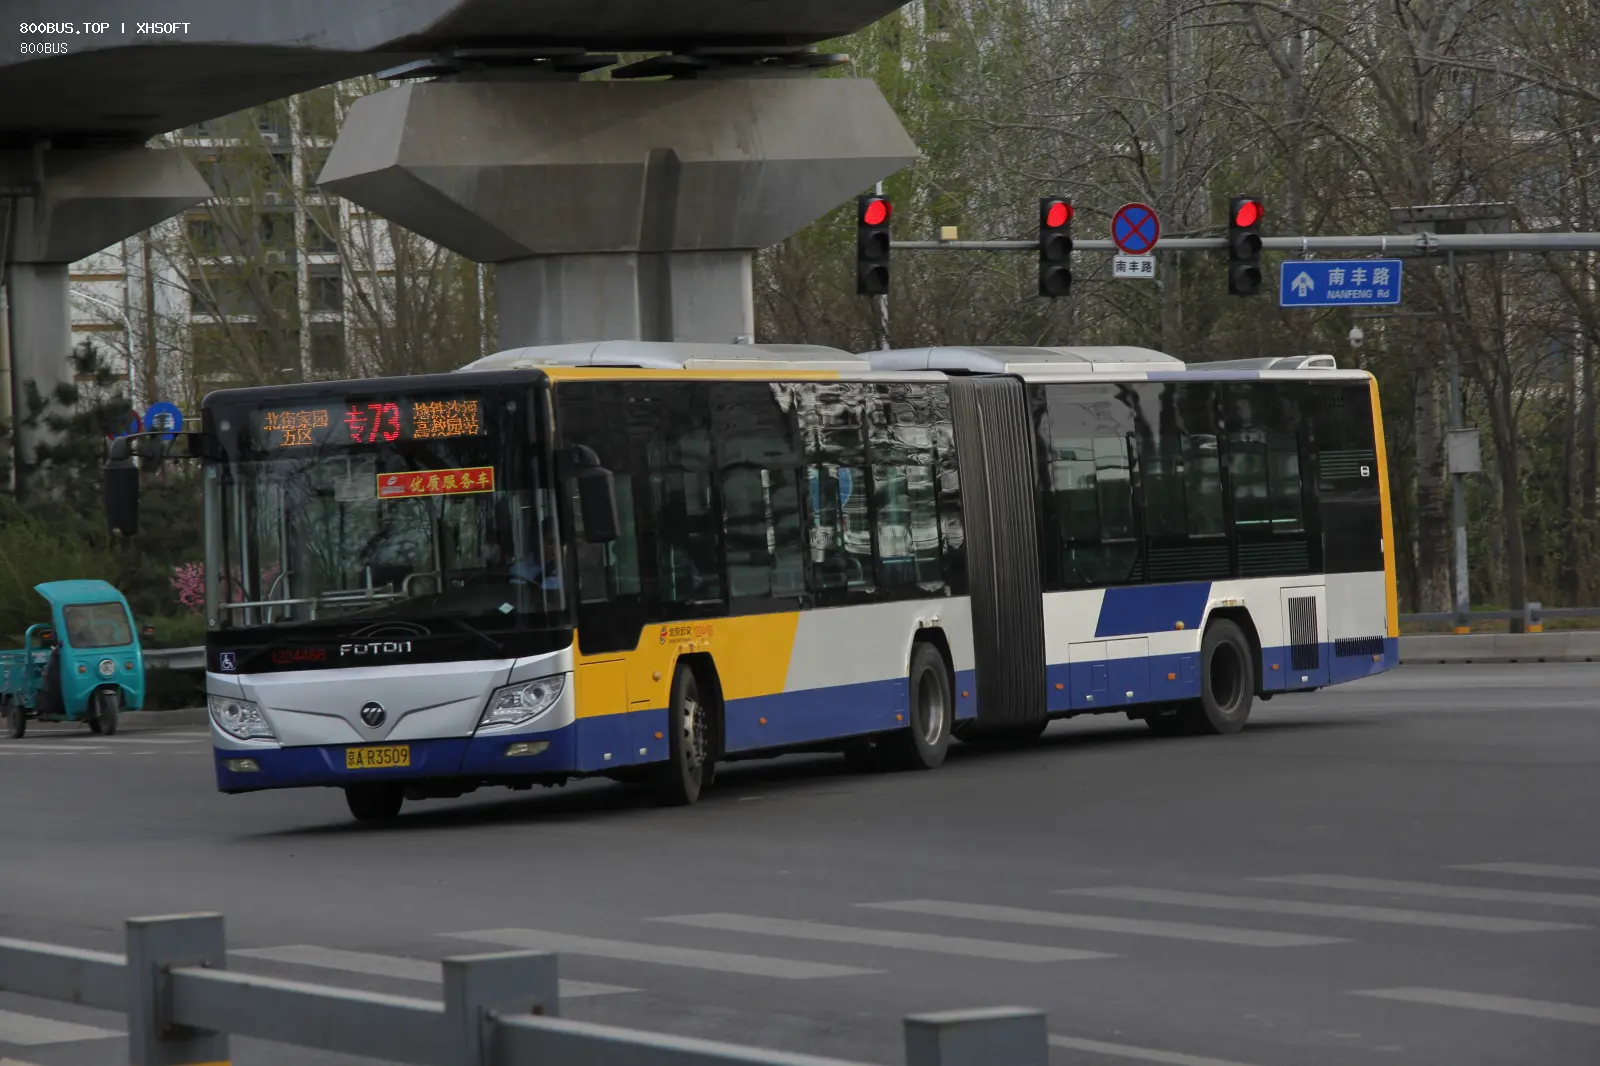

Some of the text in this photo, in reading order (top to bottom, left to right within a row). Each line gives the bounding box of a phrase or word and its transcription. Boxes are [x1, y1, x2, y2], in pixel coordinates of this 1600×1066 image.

[1115, 260, 1152, 273] 南丰路
[1328, 267, 1390, 286] 南丰路
[1327, 289, 1390, 299] NANFENG Rd
[343, 402, 400, 442] 专73
[280, 427, 313, 447] 五区
[410, 471, 489, 492] 优质服务车
